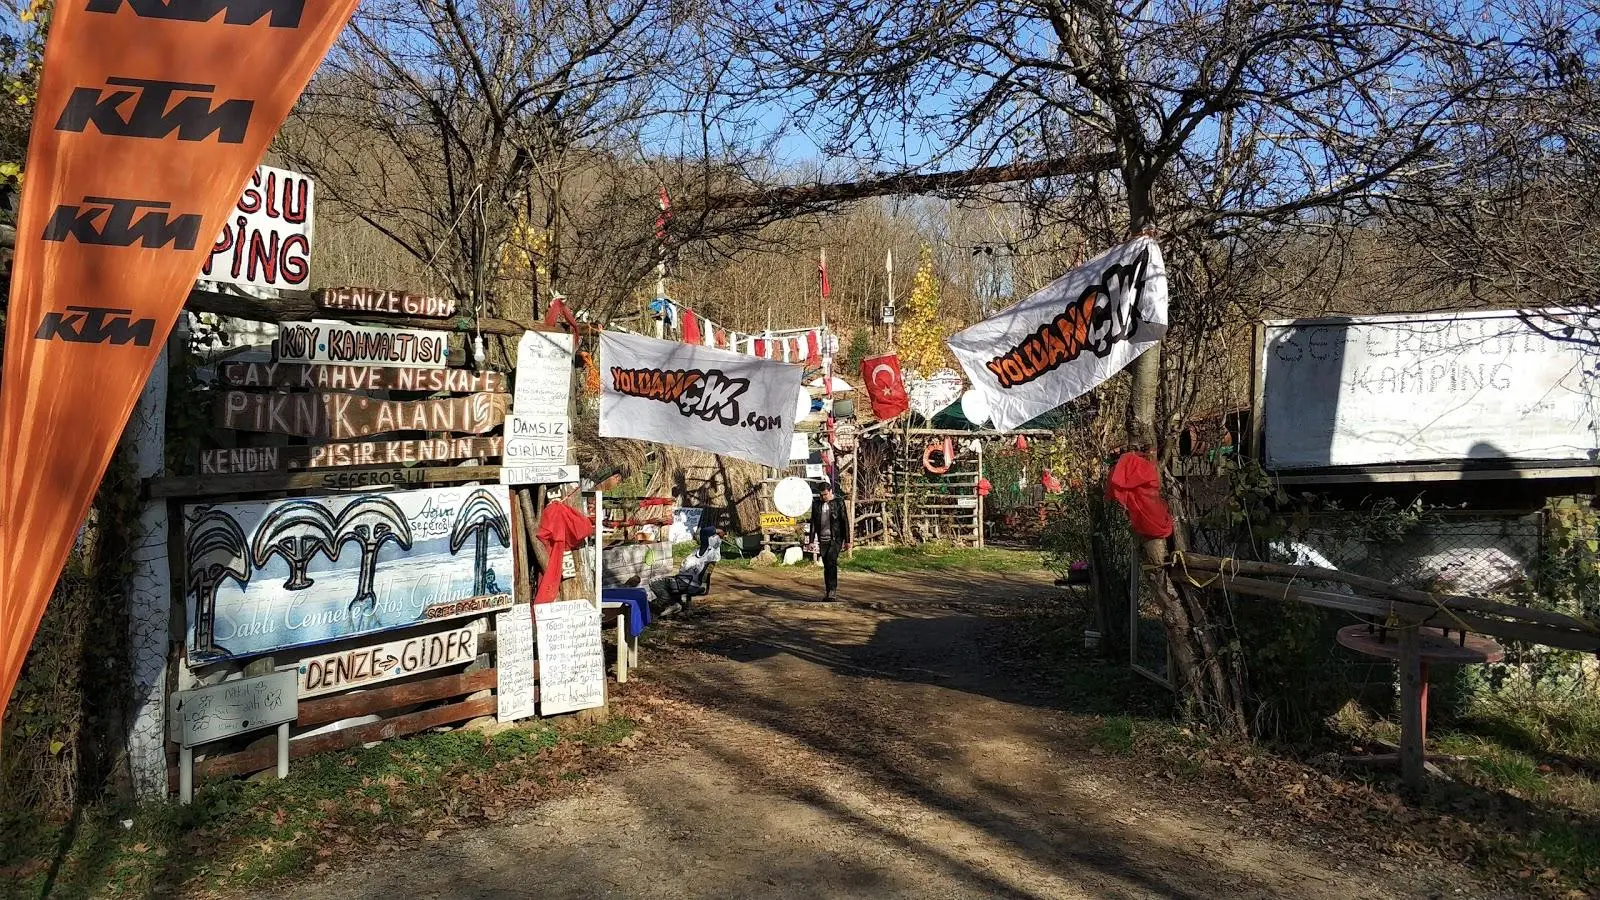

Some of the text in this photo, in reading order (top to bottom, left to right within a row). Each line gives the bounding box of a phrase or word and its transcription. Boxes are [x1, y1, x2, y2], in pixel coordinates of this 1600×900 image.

[54, 76, 255, 144] KTM
[41, 195, 203, 250] KTM
[35, 305, 156, 347] KTM
[281, 324, 320, 360] KÖY
[513, 418, 565, 436] DAMSIZ
